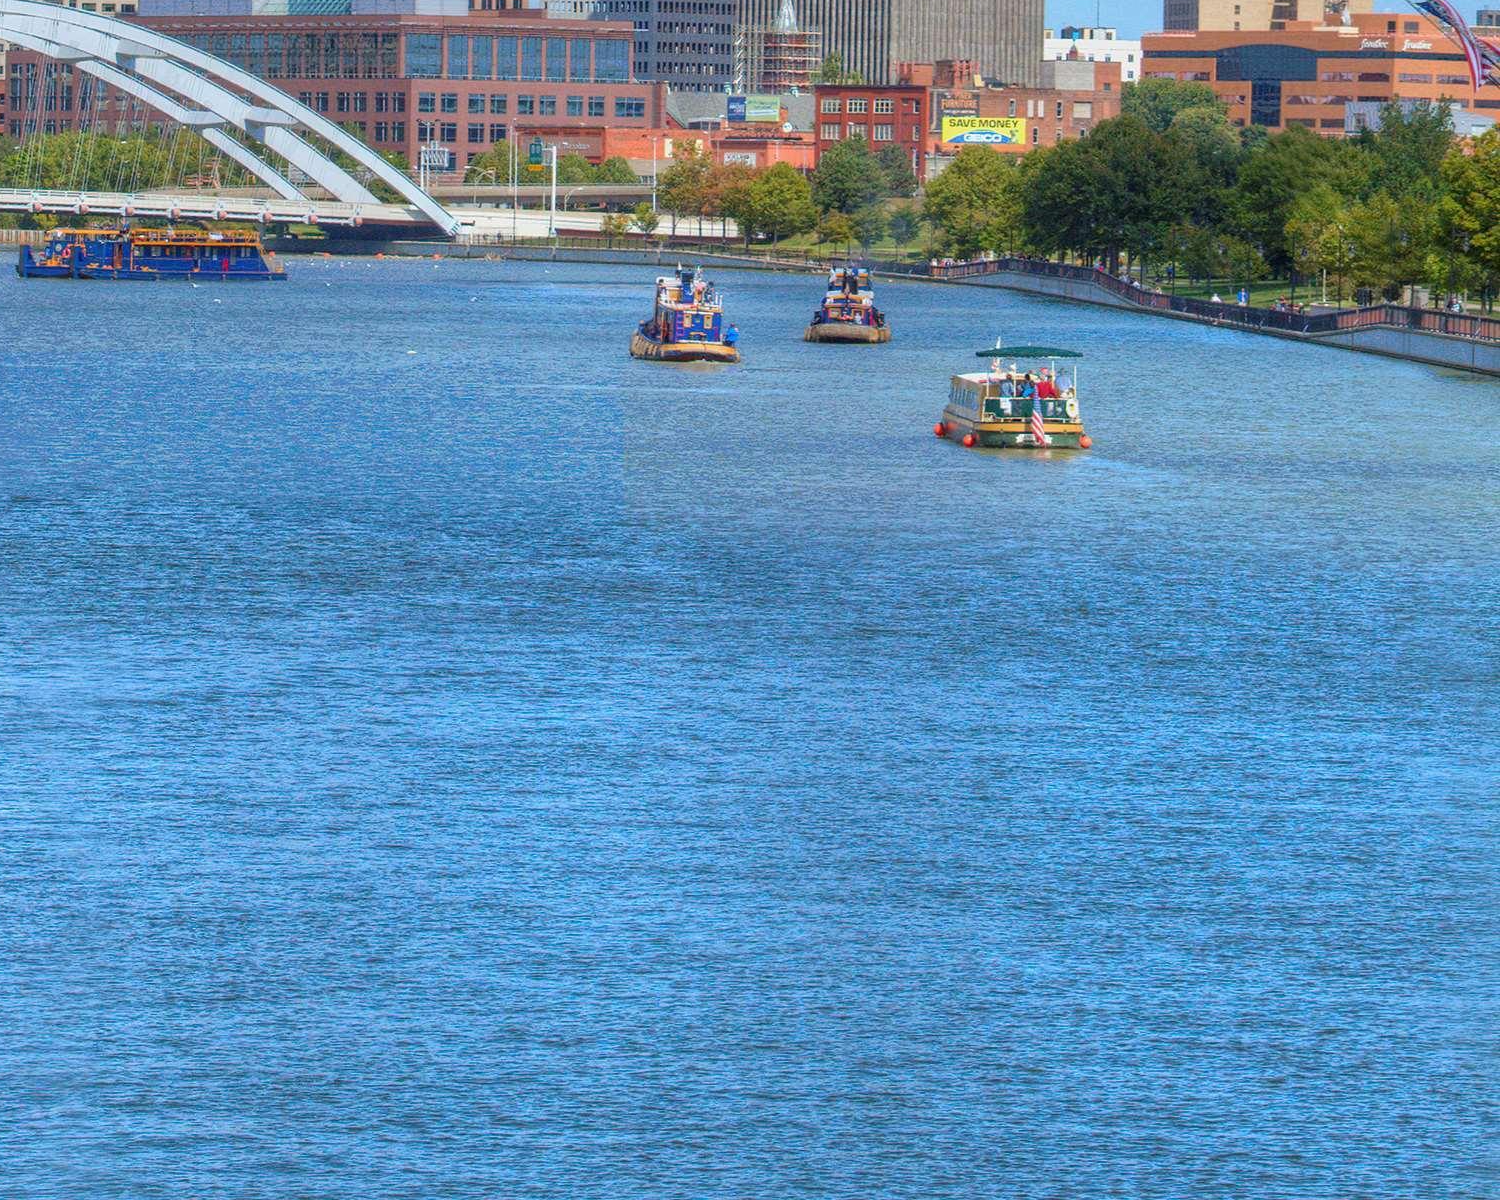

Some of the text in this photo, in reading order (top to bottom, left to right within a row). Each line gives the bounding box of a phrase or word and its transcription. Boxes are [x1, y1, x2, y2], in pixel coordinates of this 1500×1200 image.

[949, 118, 1019, 128] SAVE MONEY
[963, 133, 1002, 143] GEICO
